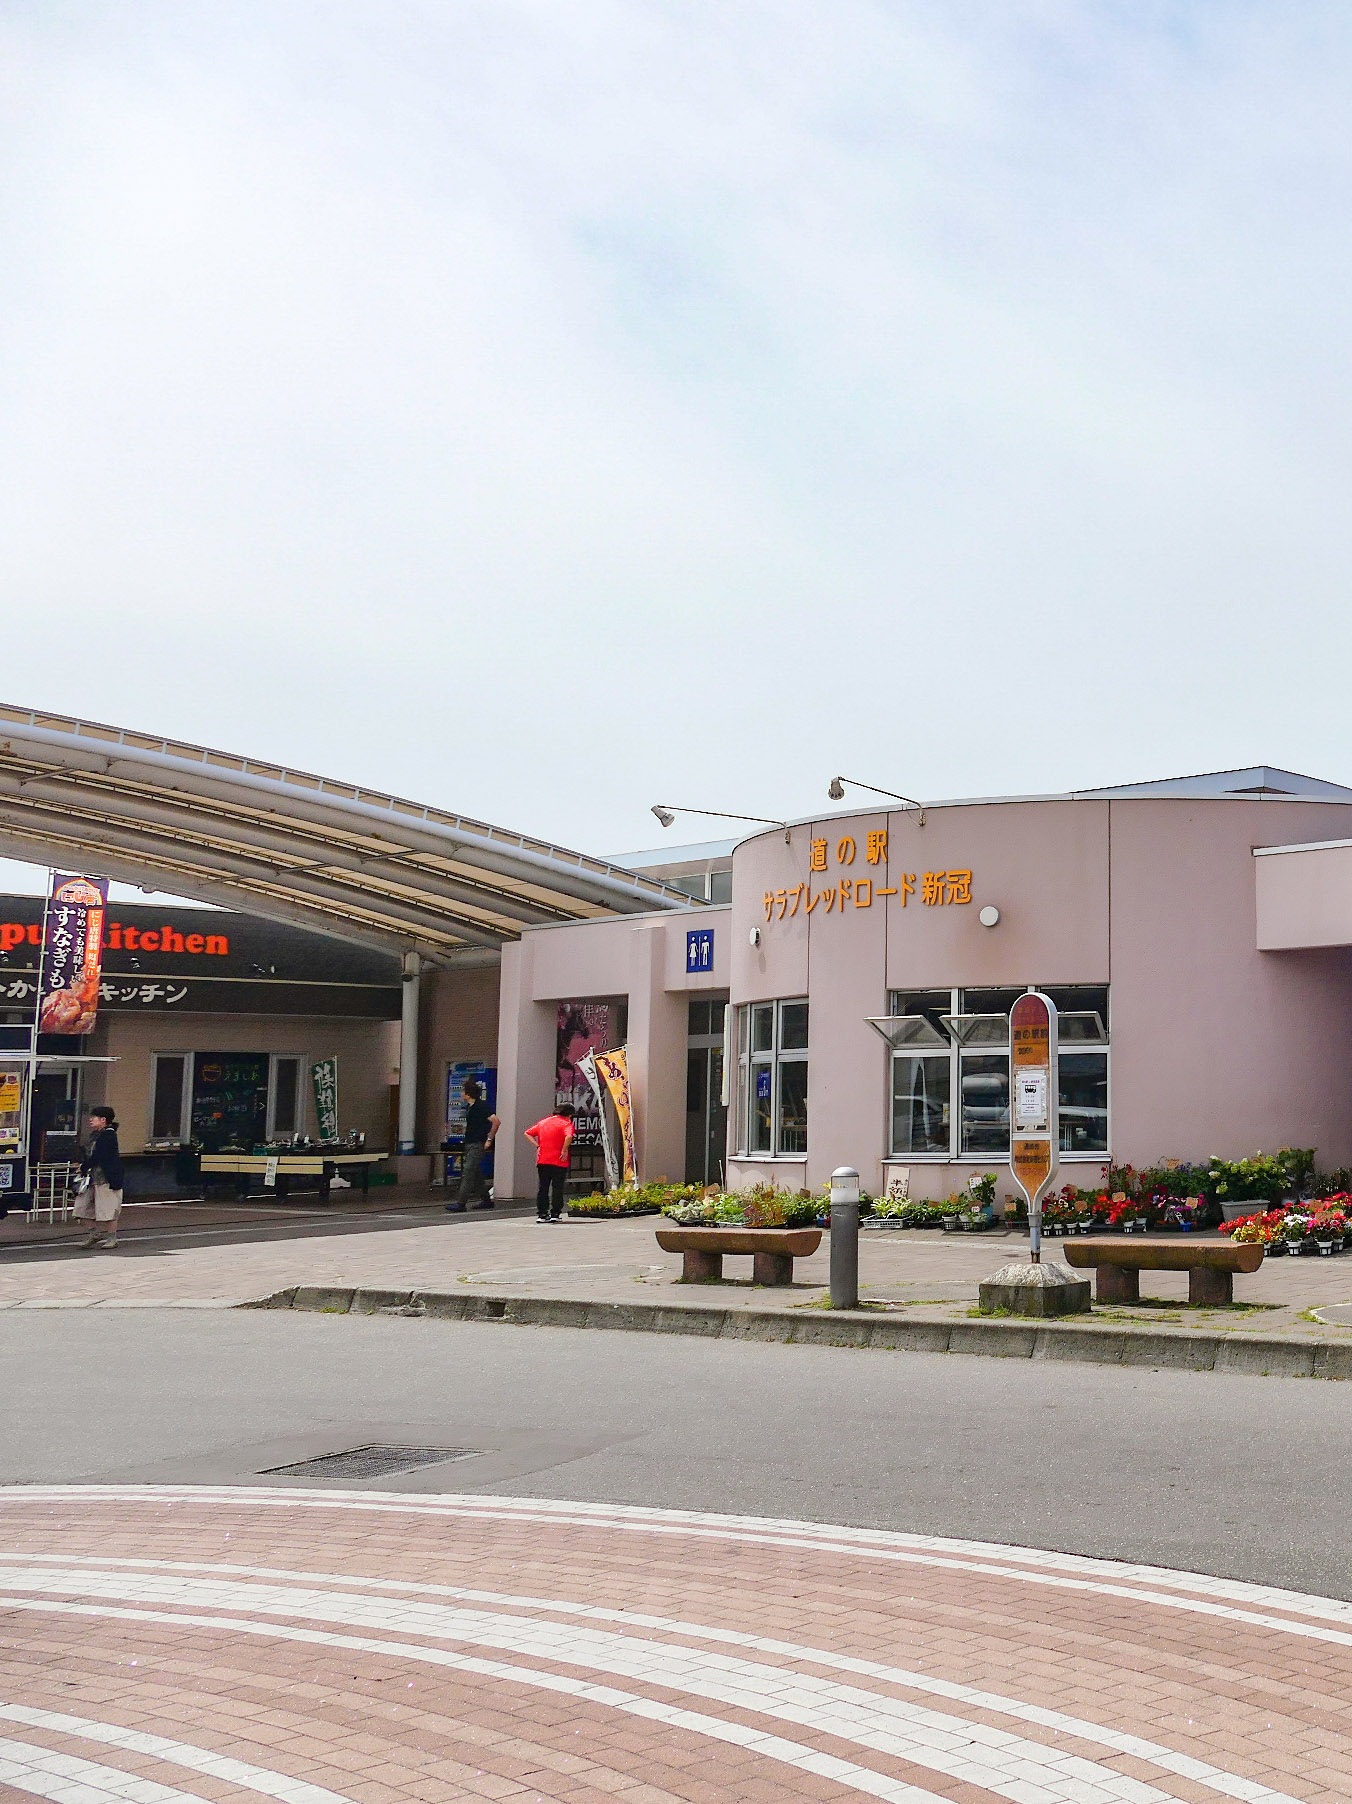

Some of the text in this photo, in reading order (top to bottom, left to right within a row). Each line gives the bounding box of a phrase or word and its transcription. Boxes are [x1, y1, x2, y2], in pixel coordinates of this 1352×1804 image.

[809, 829, 888, 872] 道の駅
[762, 869, 973, 923] サラブレッドロード新冠
[49, 905, 76, 989] すなぎも
[101, 922, 230, 956] itchen
